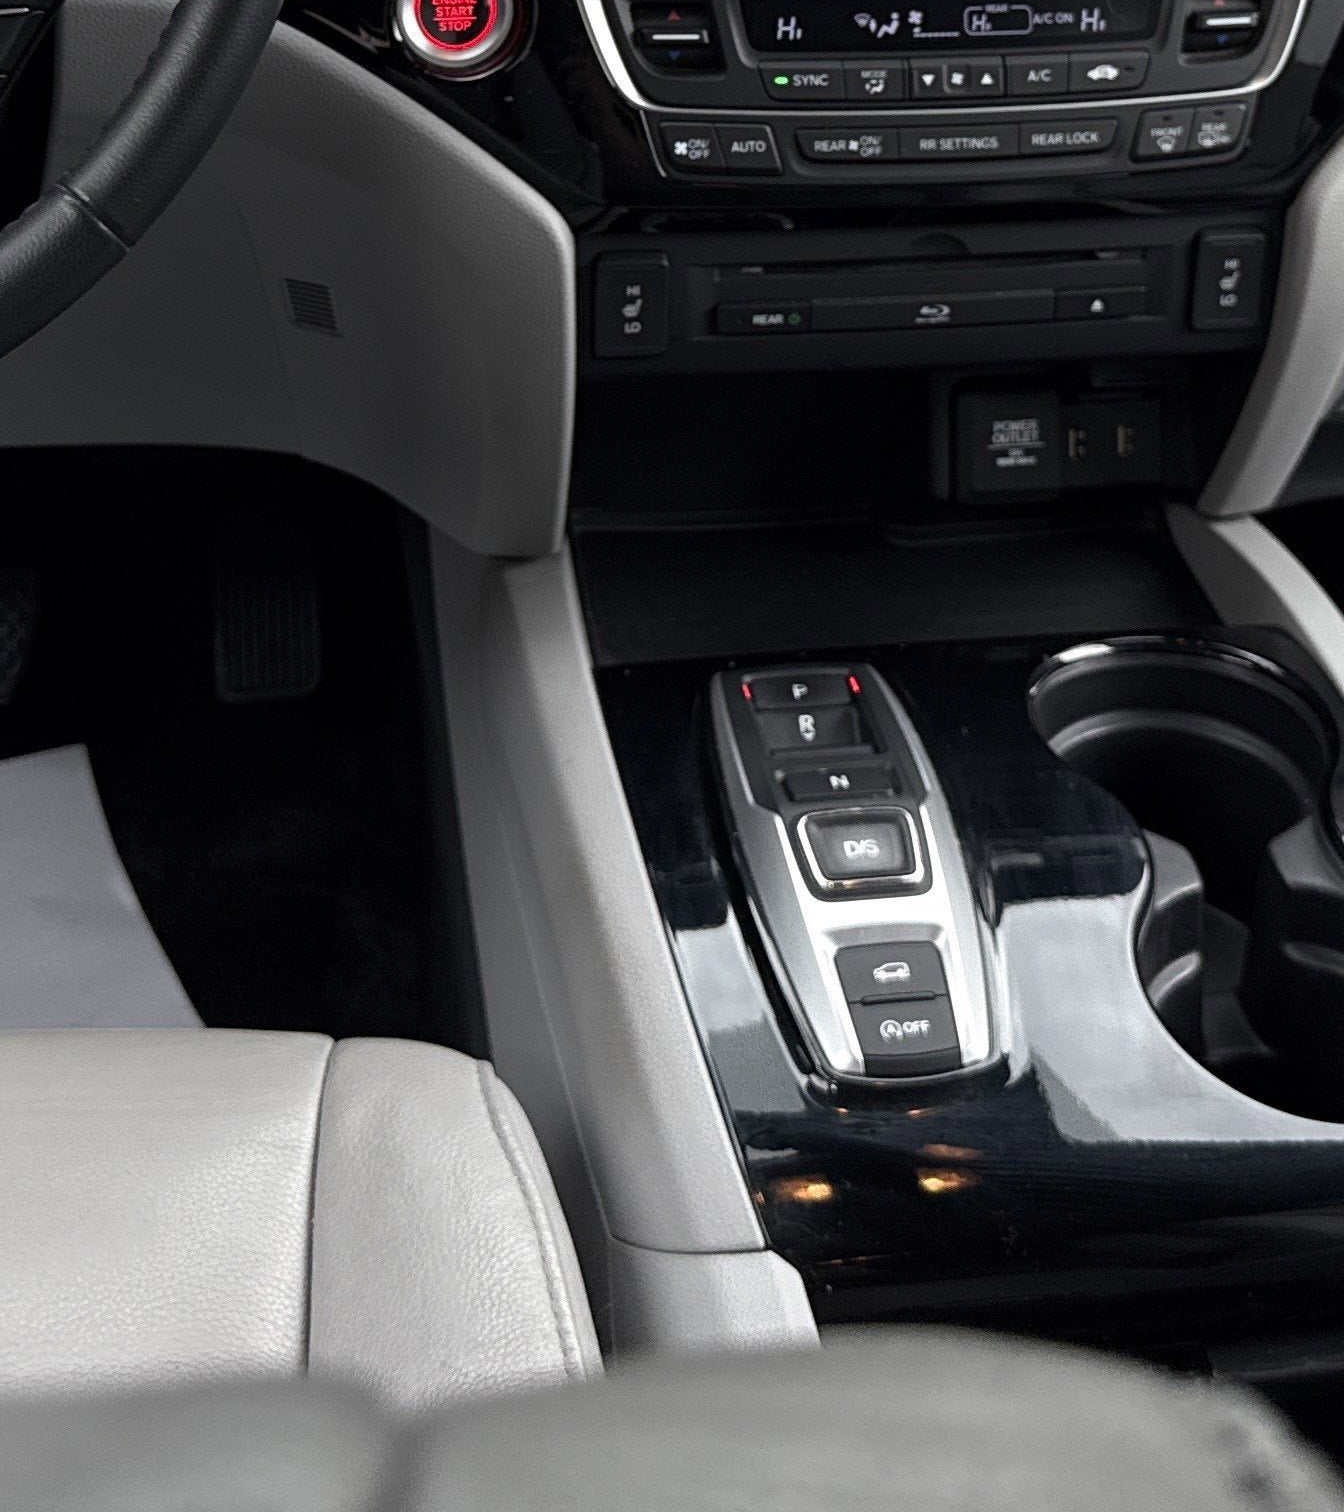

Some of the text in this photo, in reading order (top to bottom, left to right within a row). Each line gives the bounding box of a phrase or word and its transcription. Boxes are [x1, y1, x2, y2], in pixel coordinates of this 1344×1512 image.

[435, 5, 475, 18] START
[1032, 11, 1075, 25] A/C ON
[438, 20, 473, 32] STOP
[792, 73, 831, 87] SYNC
[1026, 68, 1053, 83] A/C
[813, 139, 847, 153] REAR
[919, 136, 999, 151] RR SETTINGS
[1031, 131, 1100, 146] REAR LOCK
[730, 139, 767, 154] AUTO
[859, 145, 883, 158] OFF
[688, 149, 711, 161] OFF
[791, 682, 808, 700] P
[798, 713, 815, 733] R
[828, 773, 851, 790] N
[843, 839, 881, 858] D/S
[902, 1019, 931, 1035] OFF
